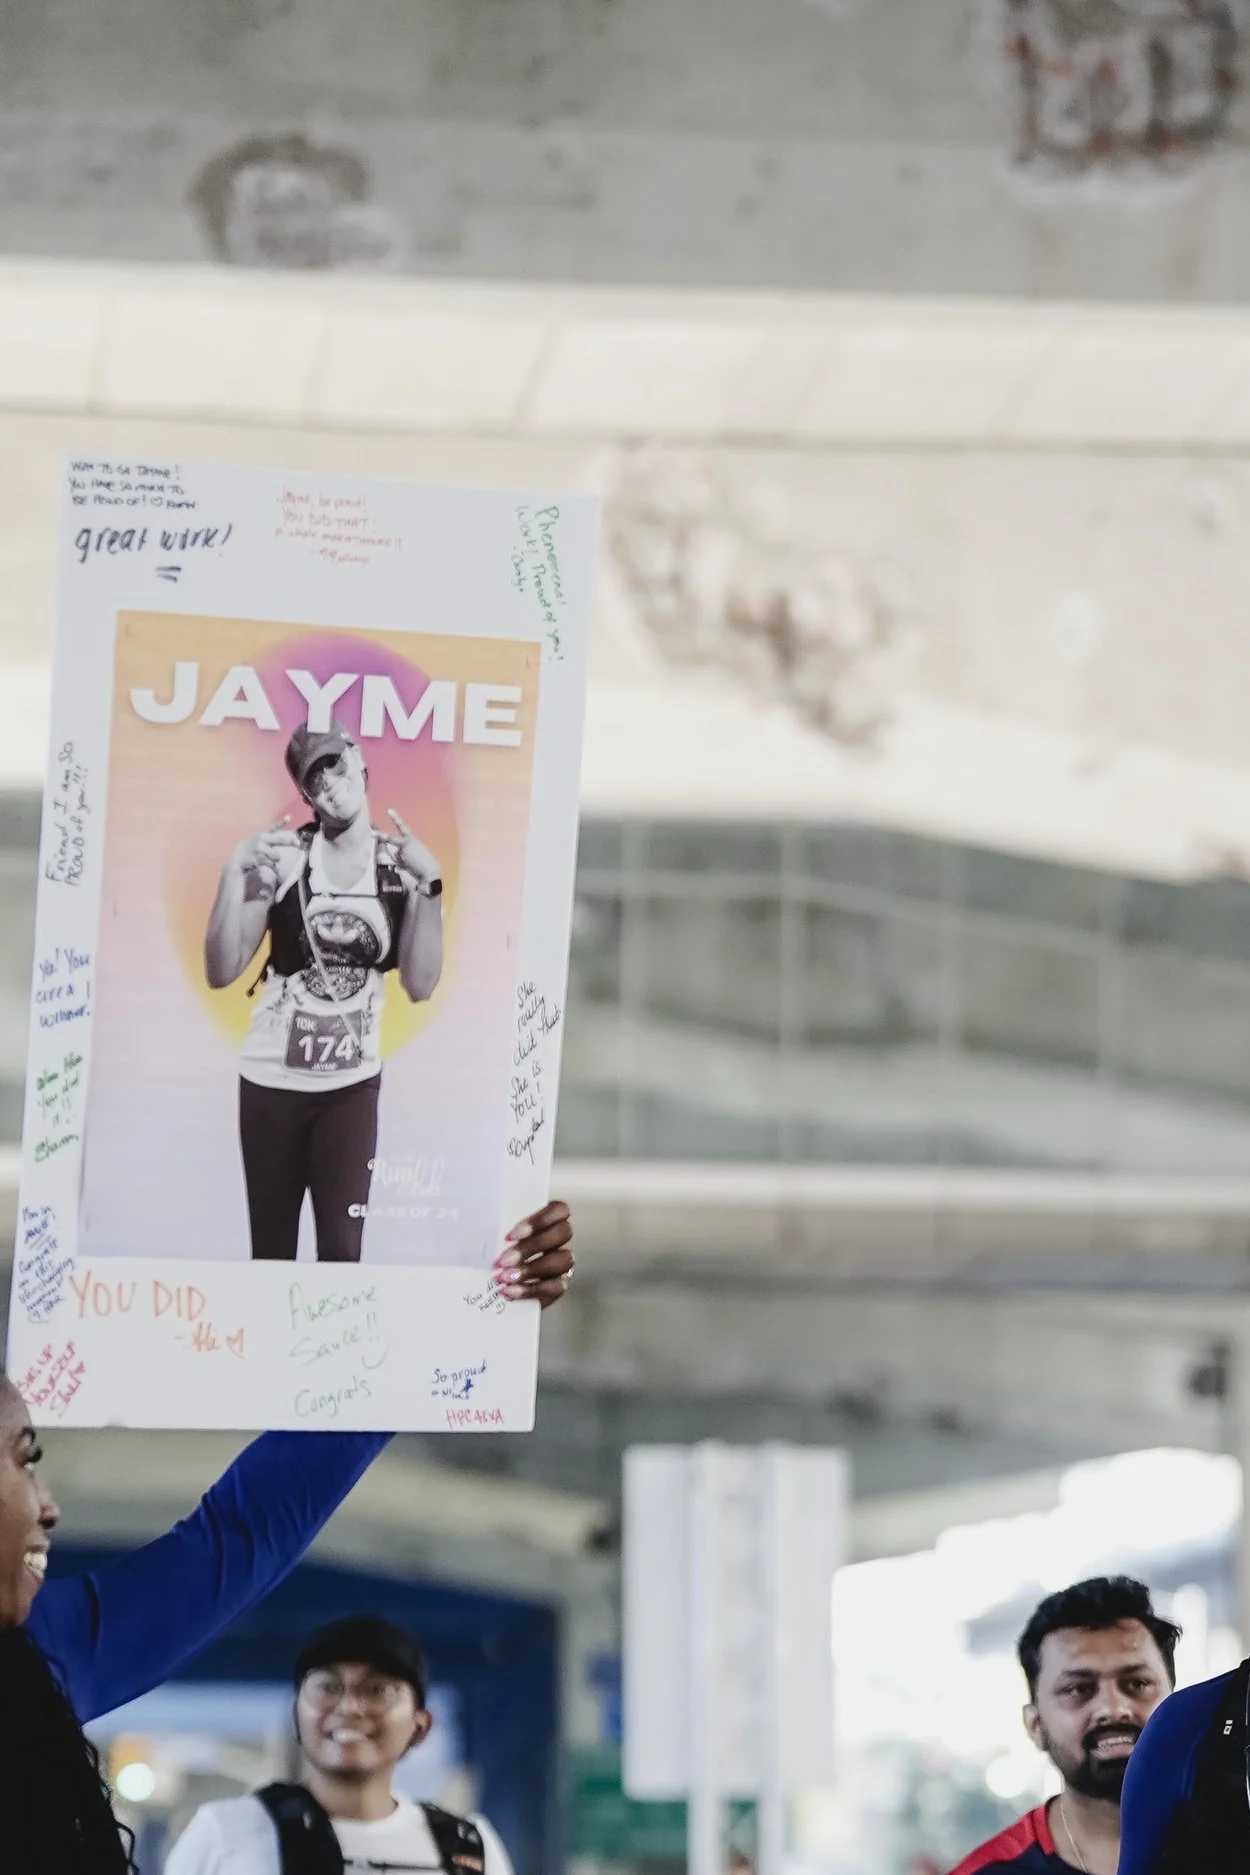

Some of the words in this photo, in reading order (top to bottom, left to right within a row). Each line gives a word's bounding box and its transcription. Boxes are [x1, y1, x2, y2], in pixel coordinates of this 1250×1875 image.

[309, 512, 332, 526] DID
[75, 526, 148, 563] great
[130, 662, 522, 747] JAYME
[46, 822, 69, 882] Friend
[516, 981, 536, 1009] She
[295, 1016, 317, 1031] 10K
[517, 995, 545, 1033] really
[298, 1034, 353, 1063] 174
[513, 1031, 538, 1067] did
[511, 1074, 528, 1102] She
[531, 1060, 542, 1079] is
[68, 1270, 137, 1319] YOU
[153, 1280, 207, 1321] DID
[288, 1281, 379, 1331] Awesome
[463, 1294, 483, 1306] You
[452, 1358, 488, 1386] proud
[294, 1374, 371, 1418] Congrats
